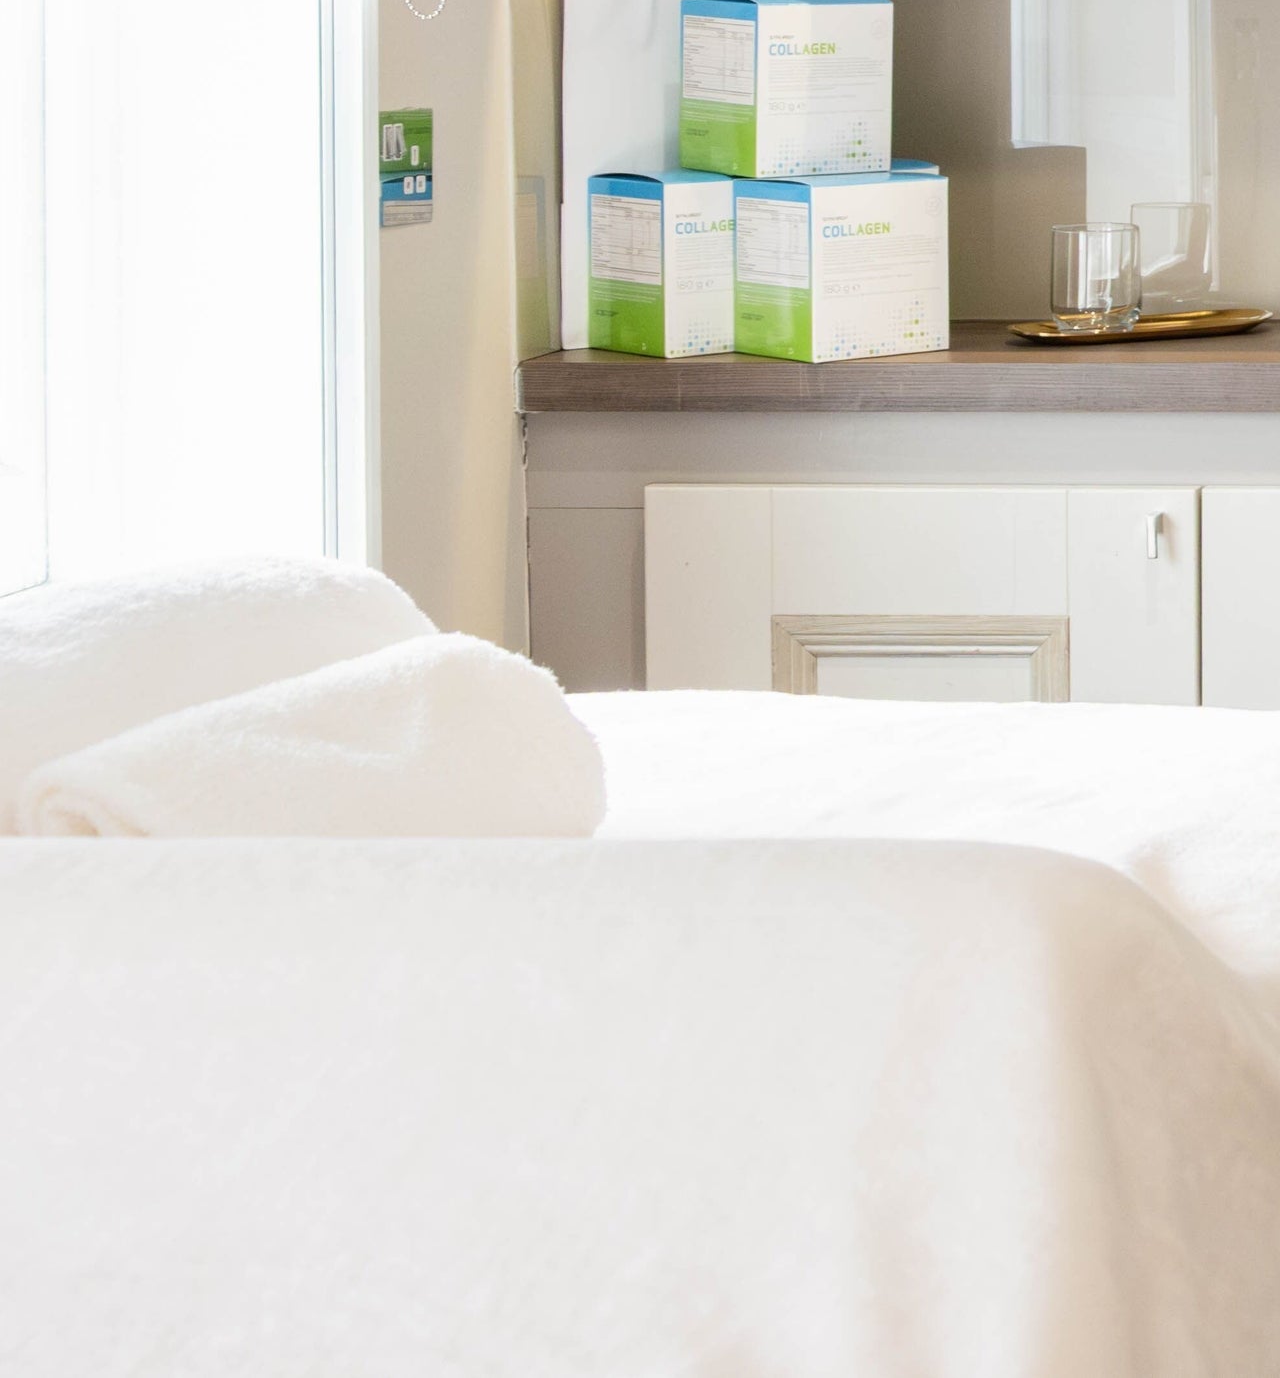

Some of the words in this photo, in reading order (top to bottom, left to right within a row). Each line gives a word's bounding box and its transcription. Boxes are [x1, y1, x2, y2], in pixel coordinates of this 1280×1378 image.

[768, 42, 837, 56] COLLAGEN
[675, 219, 736, 235] COLLAGE
[822, 221, 891, 238] COLLAGEN
